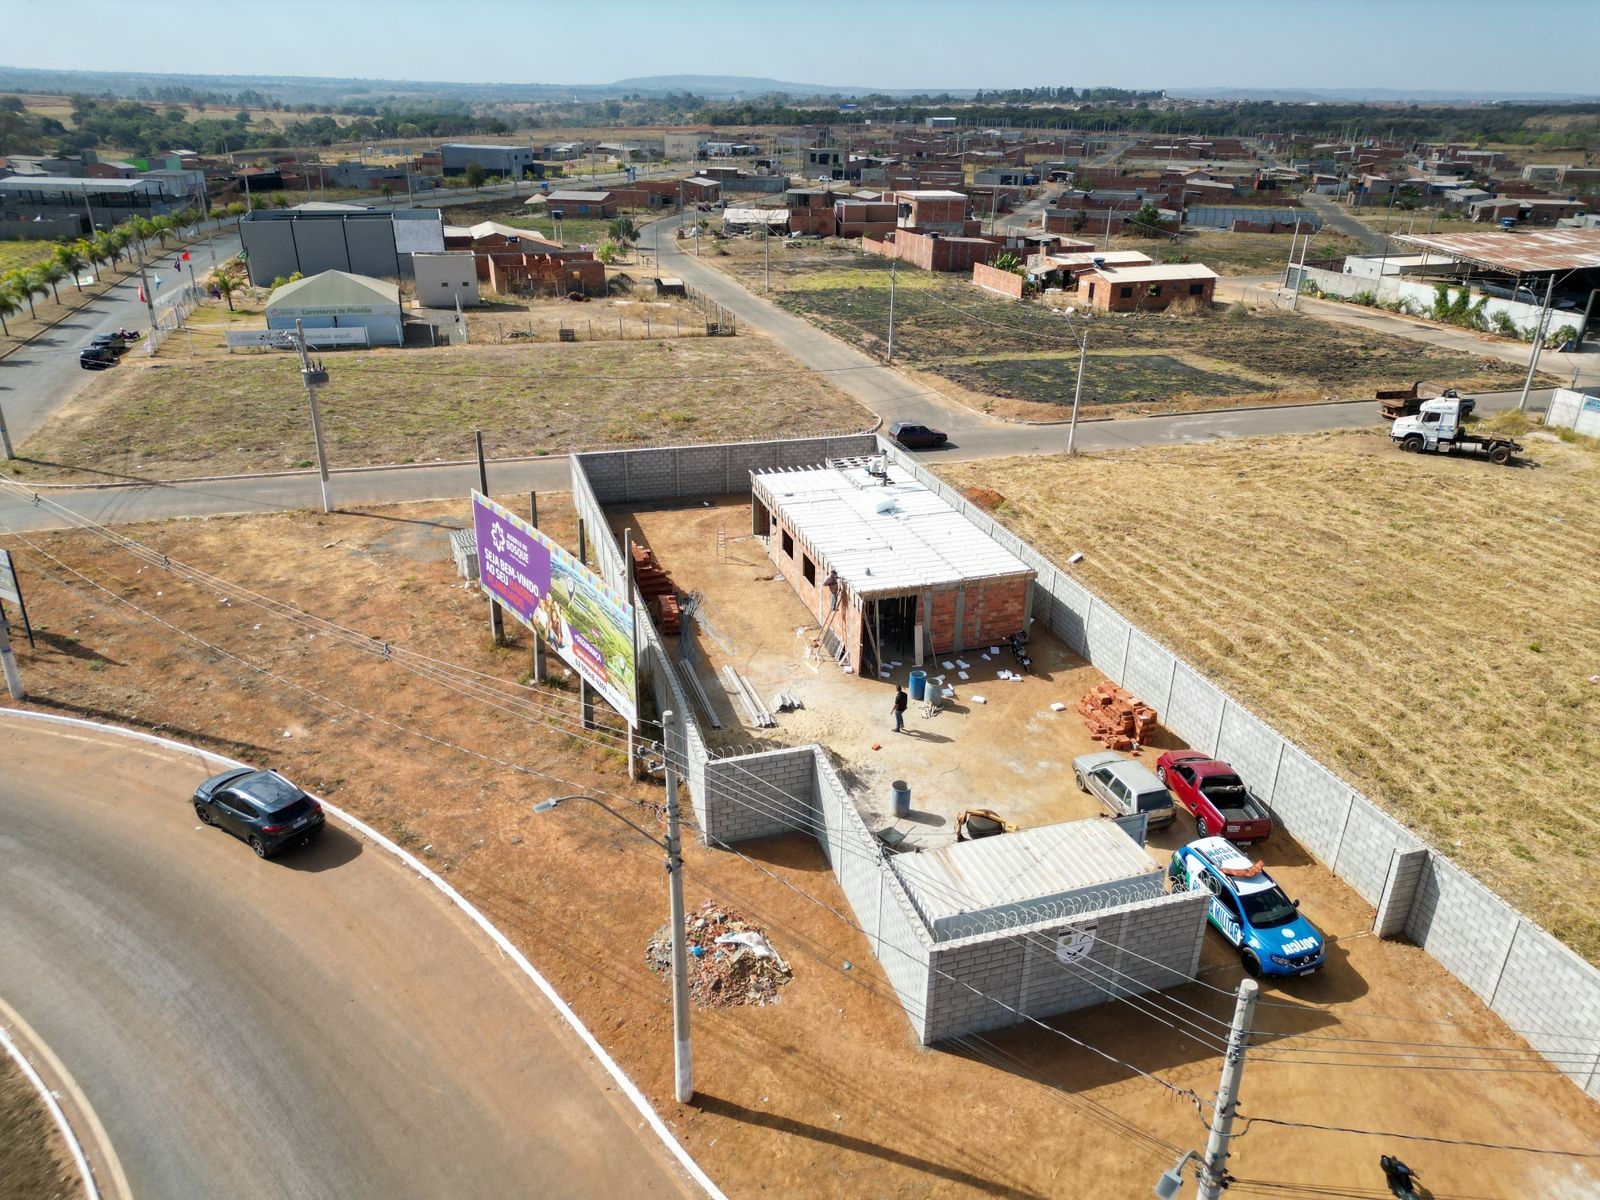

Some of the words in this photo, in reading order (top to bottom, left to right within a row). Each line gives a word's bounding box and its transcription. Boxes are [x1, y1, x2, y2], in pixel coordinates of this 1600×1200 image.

[347, 306, 372, 314] Plantão
[506, 540, 529, 563] BOSQUE
[484, 548, 500, 568] SEJA
[500, 559, 539, 597] BEM-VINDO
[486, 561, 495, 575] AO
[495, 567, 508, 586] SEU
[1215, 903, 1239, 943] MILITAR
